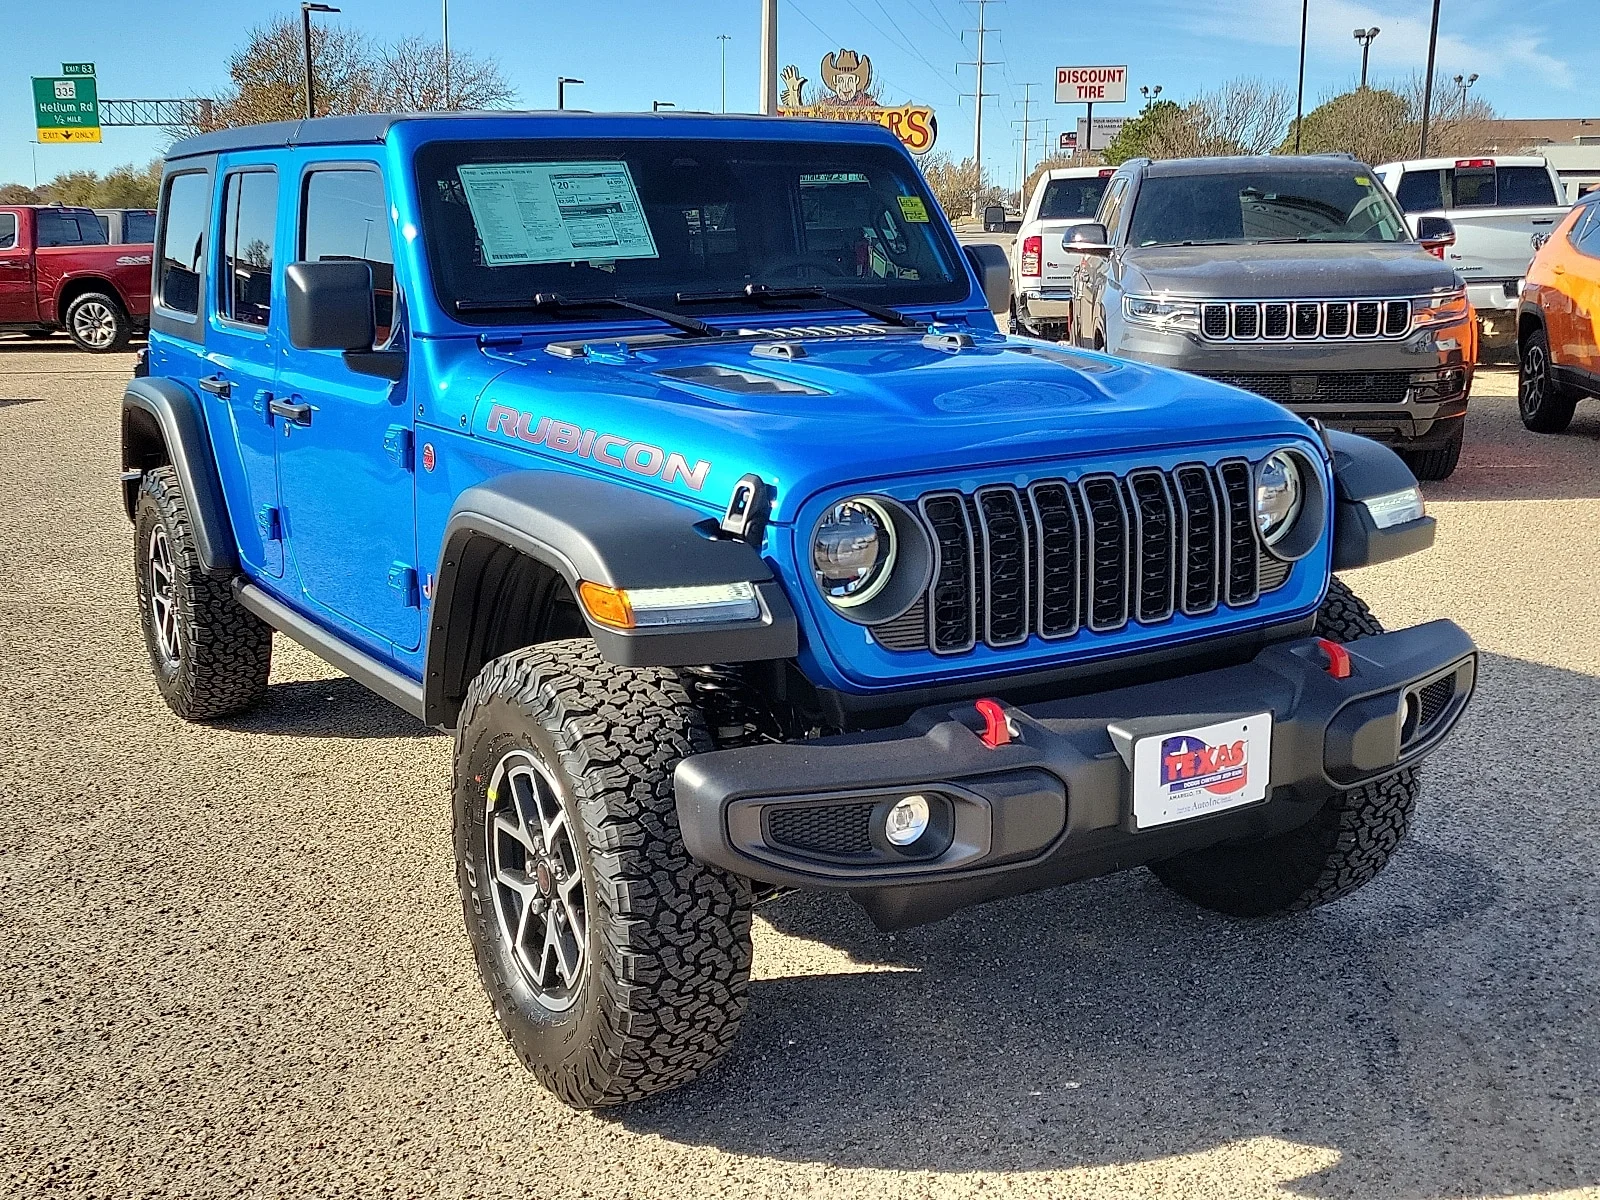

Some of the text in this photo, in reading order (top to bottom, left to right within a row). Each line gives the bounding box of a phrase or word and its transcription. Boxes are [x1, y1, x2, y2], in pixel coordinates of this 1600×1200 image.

[81, 64, 93, 73] 63
[1058, 69, 1124, 84] DISCOUNT
[55, 87, 75, 97] 335
[1077, 85, 1105, 99] TIRE
[40, 101, 94, 113] Helium Rd
[75, 131, 95, 139] ONLY
[557, 181, 569, 190] 20
[486, 404, 711, 491] RUBICON
[1164, 740, 1248, 781] TEXAS
